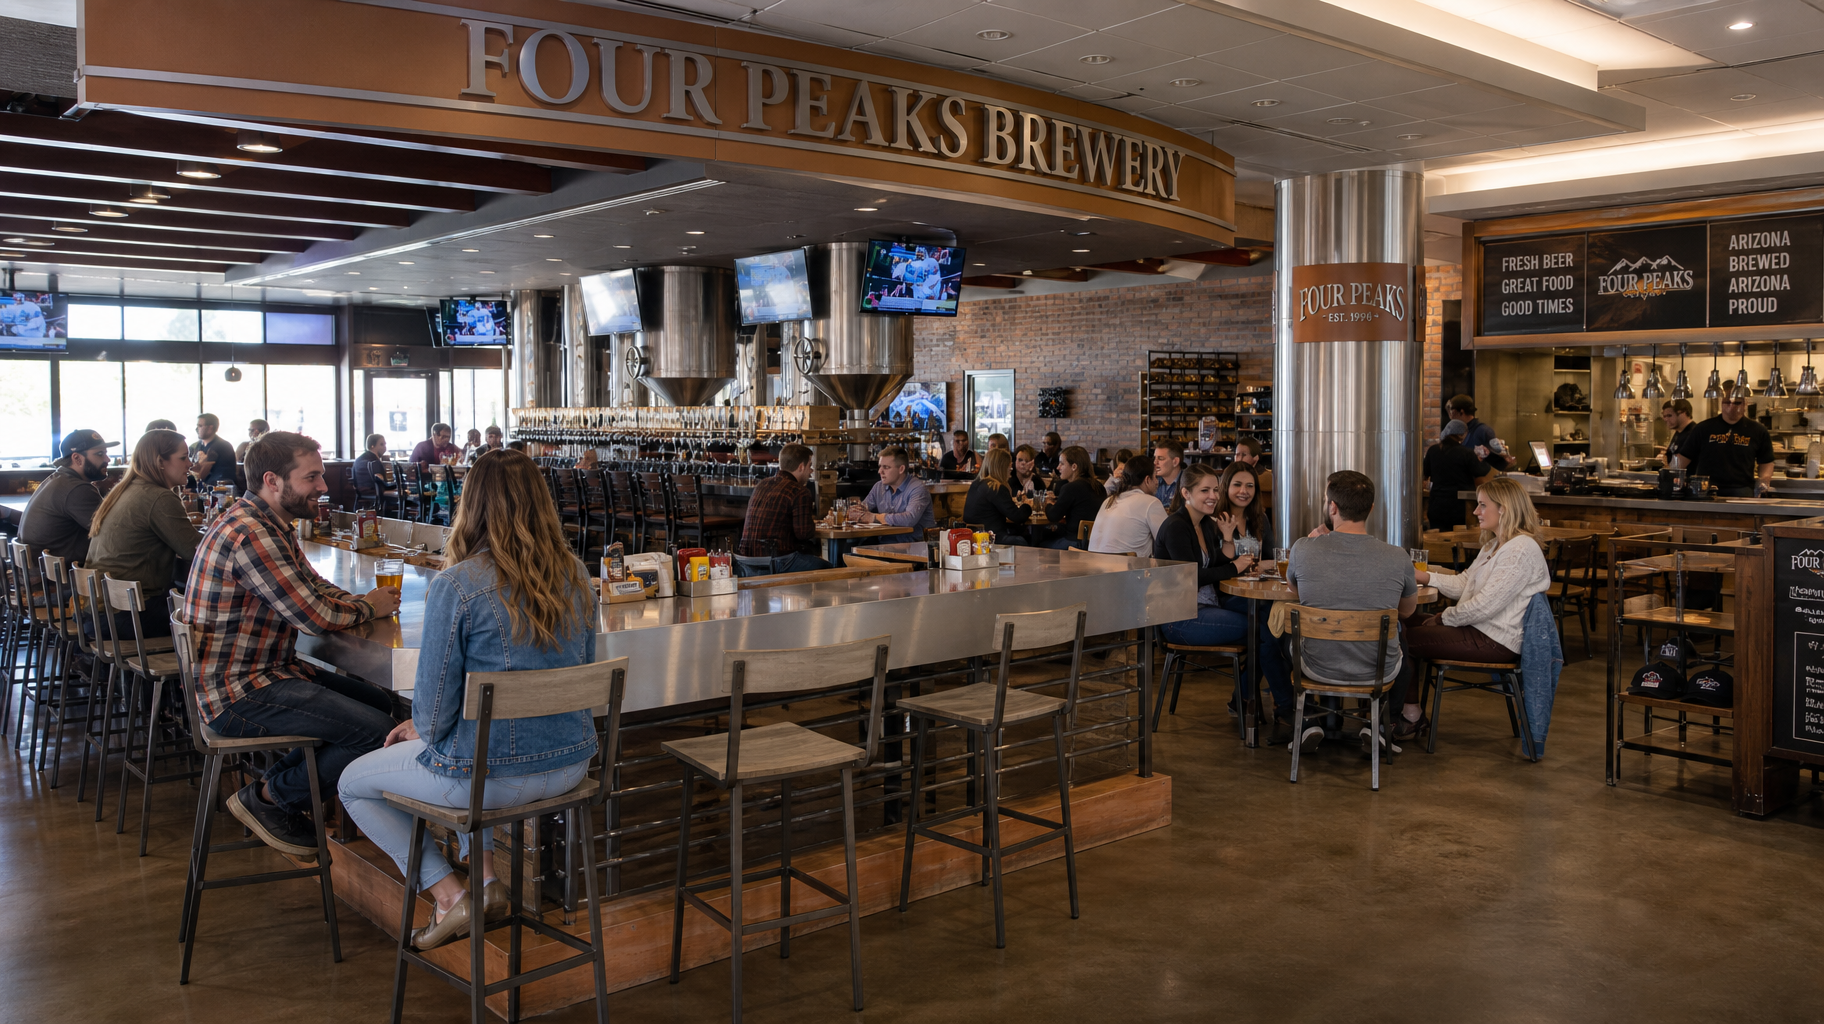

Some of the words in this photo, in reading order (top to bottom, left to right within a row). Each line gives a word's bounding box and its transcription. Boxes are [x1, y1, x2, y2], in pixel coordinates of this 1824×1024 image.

[459, 18, 723, 125] FOUR
[740, 60, 968, 158] PEAKS
[980, 103, 1186, 202] BREWERY
[1728, 230, 1791, 251] ARIZONA
[1502, 255, 1539, 272] FRESH
[1543, 252, 1574, 269] BEER
[1729, 252, 1790, 272] BREWED
[1501, 277, 1539, 294] GREAT
[1542, 275, 1574, 291] FOOD
[1598, 274, 1639, 295] FOUR
[1642, 270, 1694, 291] PEAKS
[1728, 274, 1791, 294] ARIZONA
[1299, 283, 1346, 322] FOUR
[1350, 282, 1405, 322] PEAKS
[1501, 300, 1533, 316] GOOD
[1536, 298, 1574, 314] TIMES
[1728, 297, 1778, 315] PROUD
[1328, 312, 1348, 322] EST.
[1791, 555, 1821, 570] FOUR
